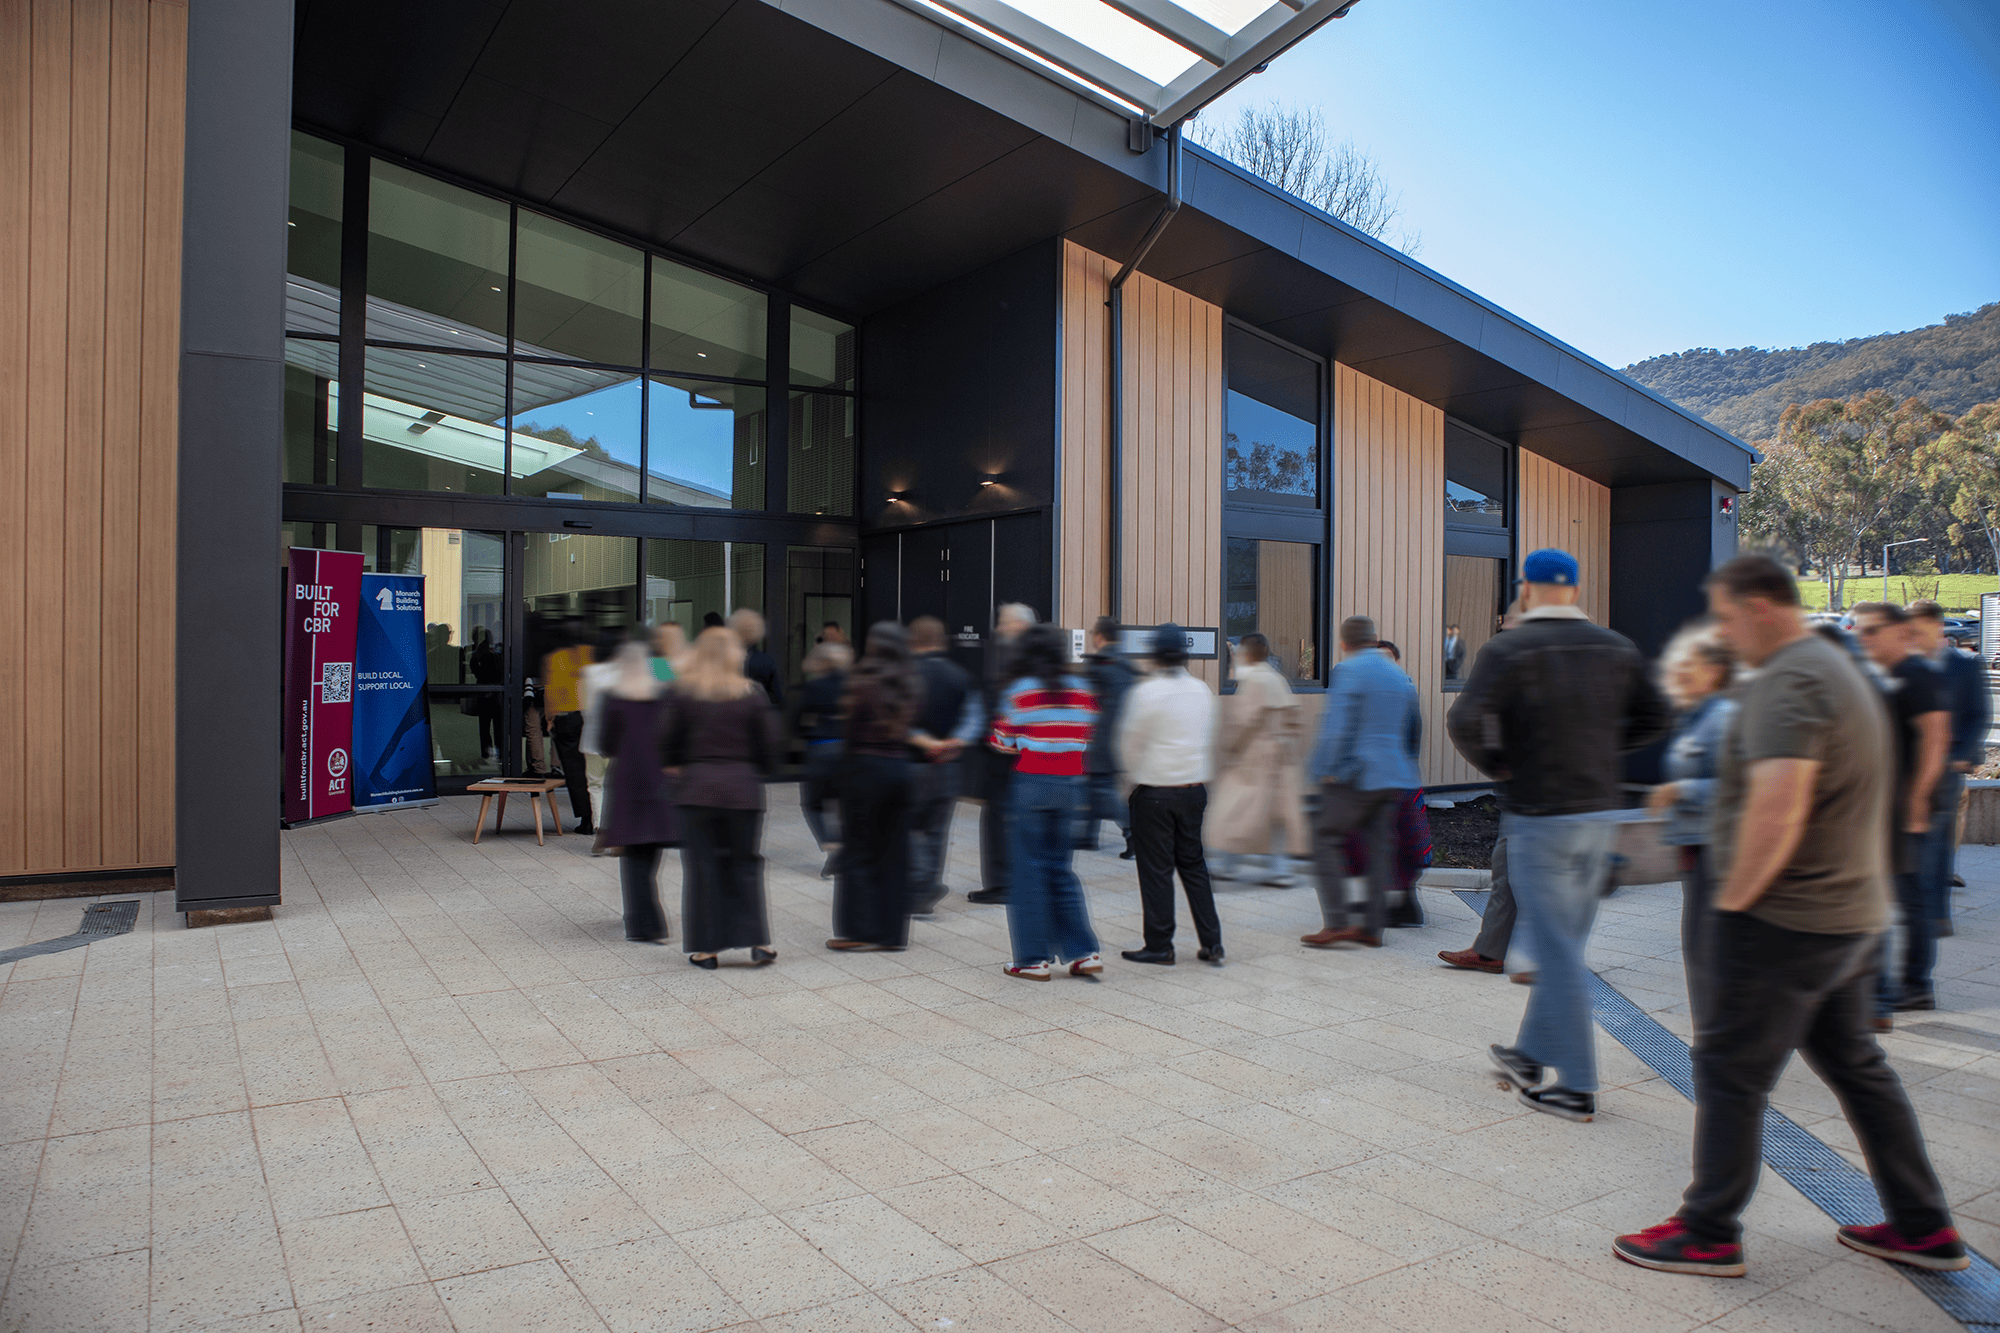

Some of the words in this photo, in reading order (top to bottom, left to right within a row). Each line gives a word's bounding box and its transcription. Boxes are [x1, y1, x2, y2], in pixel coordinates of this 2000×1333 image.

[295, 584, 333, 600] BUILT
[396, 597, 419, 605] Building
[313, 601, 339, 617] FOR
[304, 617, 331, 633] CBR
[379, 671, 403, 679] LOCAL.
[358, 682, 388, 690] SUPPORT
[390, 681, 414, 689] LOCAL.
[300, 700, 308, 800] builtforcbr.act.gov.au
[329, 778, 346, 790] ACT
